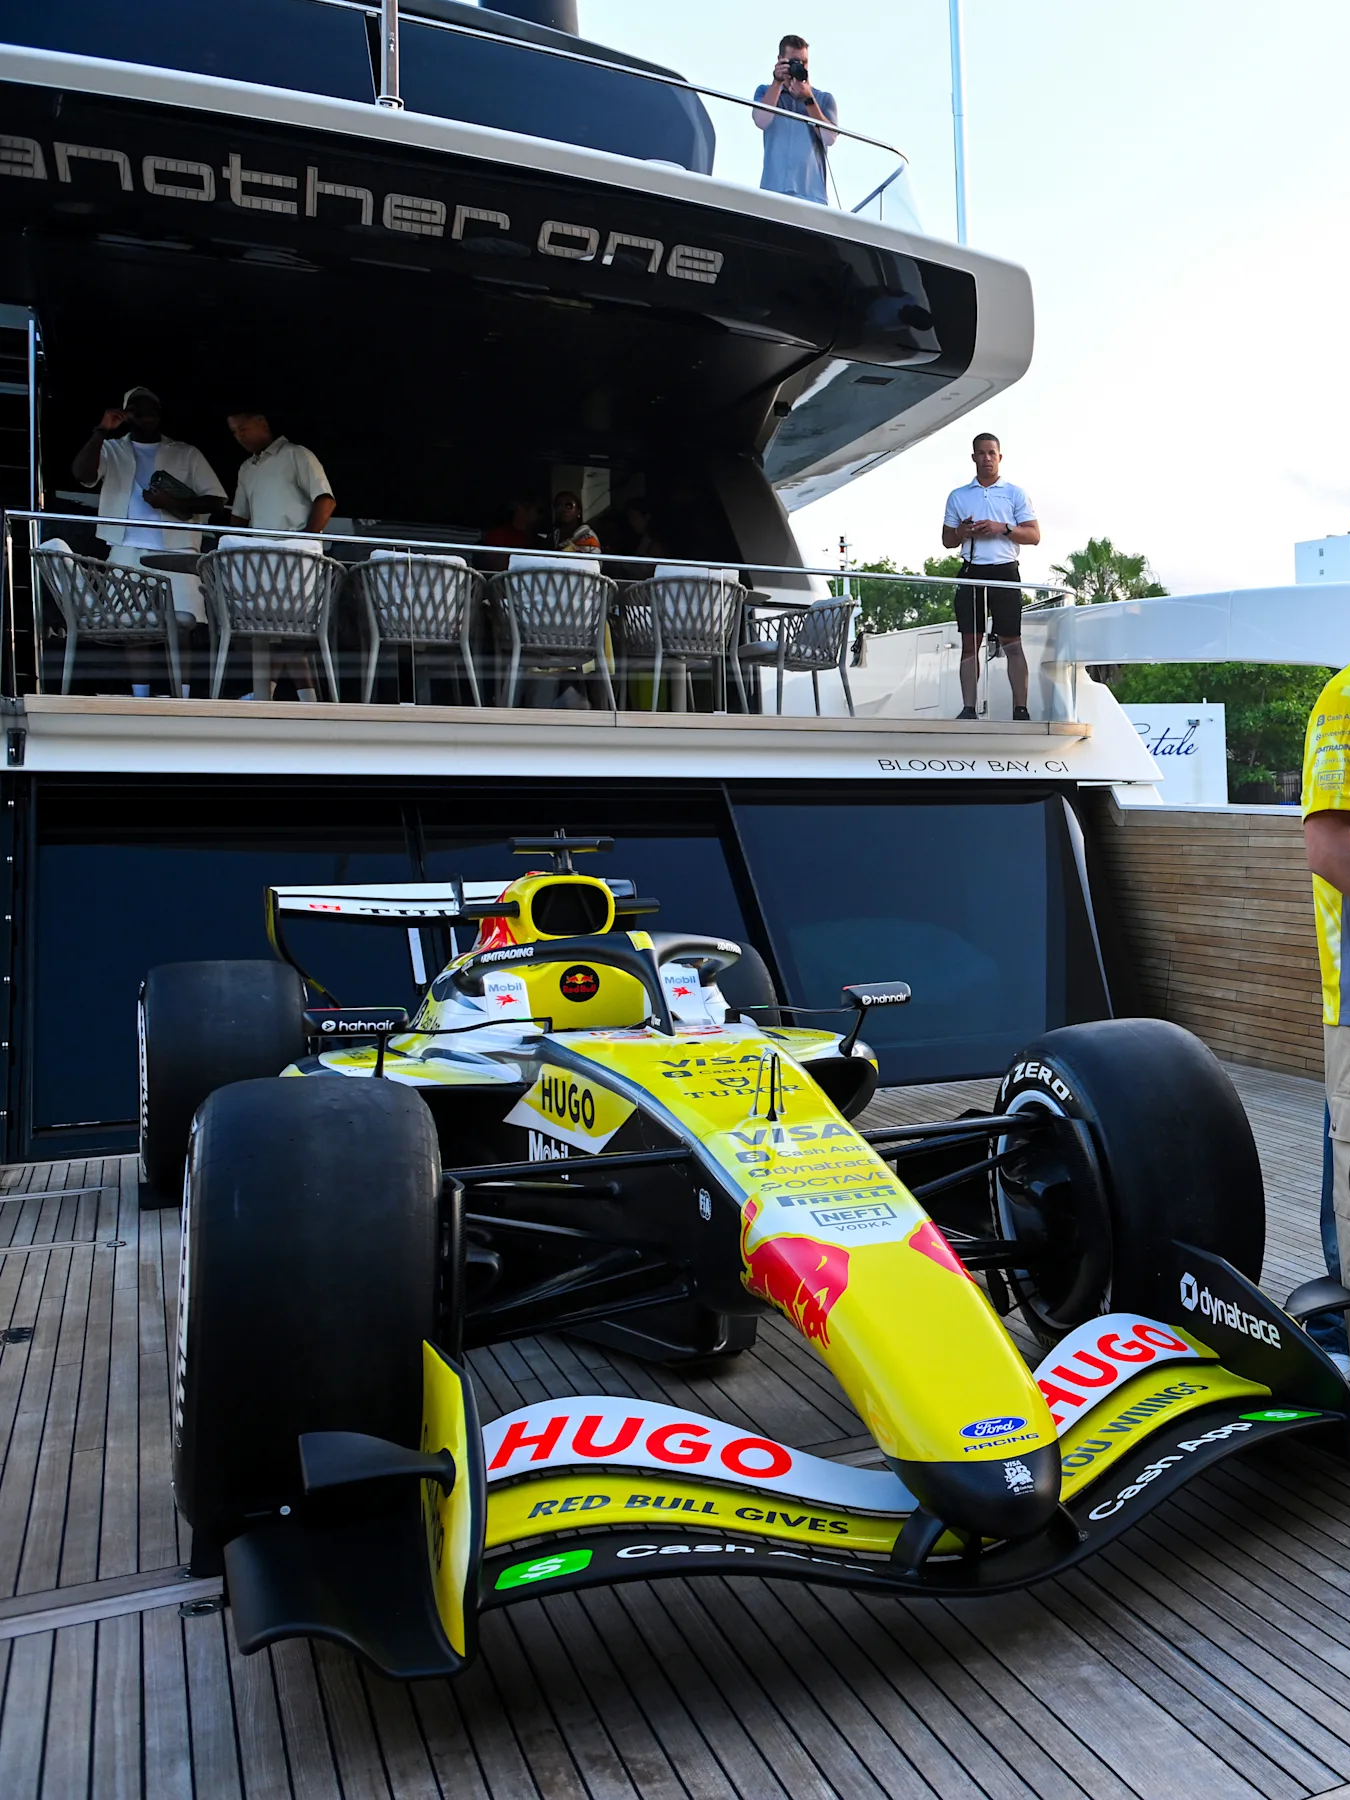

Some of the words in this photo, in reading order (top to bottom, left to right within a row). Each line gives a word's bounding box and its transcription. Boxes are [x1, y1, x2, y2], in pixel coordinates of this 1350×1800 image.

[0, 134, 510, 240] another
[537, 220, 724, 284] one
[1326, 714, 1342, 722] Cash
[878, 759, 976, 772] BLOODY
[987, 760, 1037, 773] BAY,
[1045, 761, 1069, 773] CI
[1319, 773, 1343, 782] NEFT
[488, 982, 522, 992] Mobil
[664, 976, 696, 985] Mobil
[563, 984, 579, 994] Red
[579, 984, 596, 994] Bull
[872, 992, 907, 1004] hahnair
[339, 1020, 395, 1031] hahnair
[654, 1054, 769, 1067] VISA
[699, 1067, 744, 1076] Cash
[684, 1084, 804, 1099] TUDOR
[541, 1073, 595, 1129] HUGO
[720, 1123, 852, 1146] VISA
[528, 1130, 568, 1161] Mobil
[777, 1148, 826, 1158] Cash
[830, 1145, 867, 1153] App
[774, 1158, 882, 1175] dynatrace
[785, 1171, 893, 1189] OCTAVE
[776, 1185, 897, 1208] PIRELLI
[822, 1207, 883, 1223] NEFT
[834, 1220, 892, 1232] VODKA
[1200, 1286, 1281, 1349] dynatrace
[974, 1419, 1015, 1436] Ford
[487, 1415, 792, 1479] HUGO
[963, 1432, 1040, 1453] RACING
[1002, 1460, 1022, 1468] VISA
[1088, 1454, 1184, 1521] Cash
[1177, 1421, 1253, 1452] App
[527, 1495, 611, 1519] RED
[623, 1494, 719, 1515] BULL
[735, 1508, 849, 1535] GIVES
[615, 1544, 755, 1559] Cash
